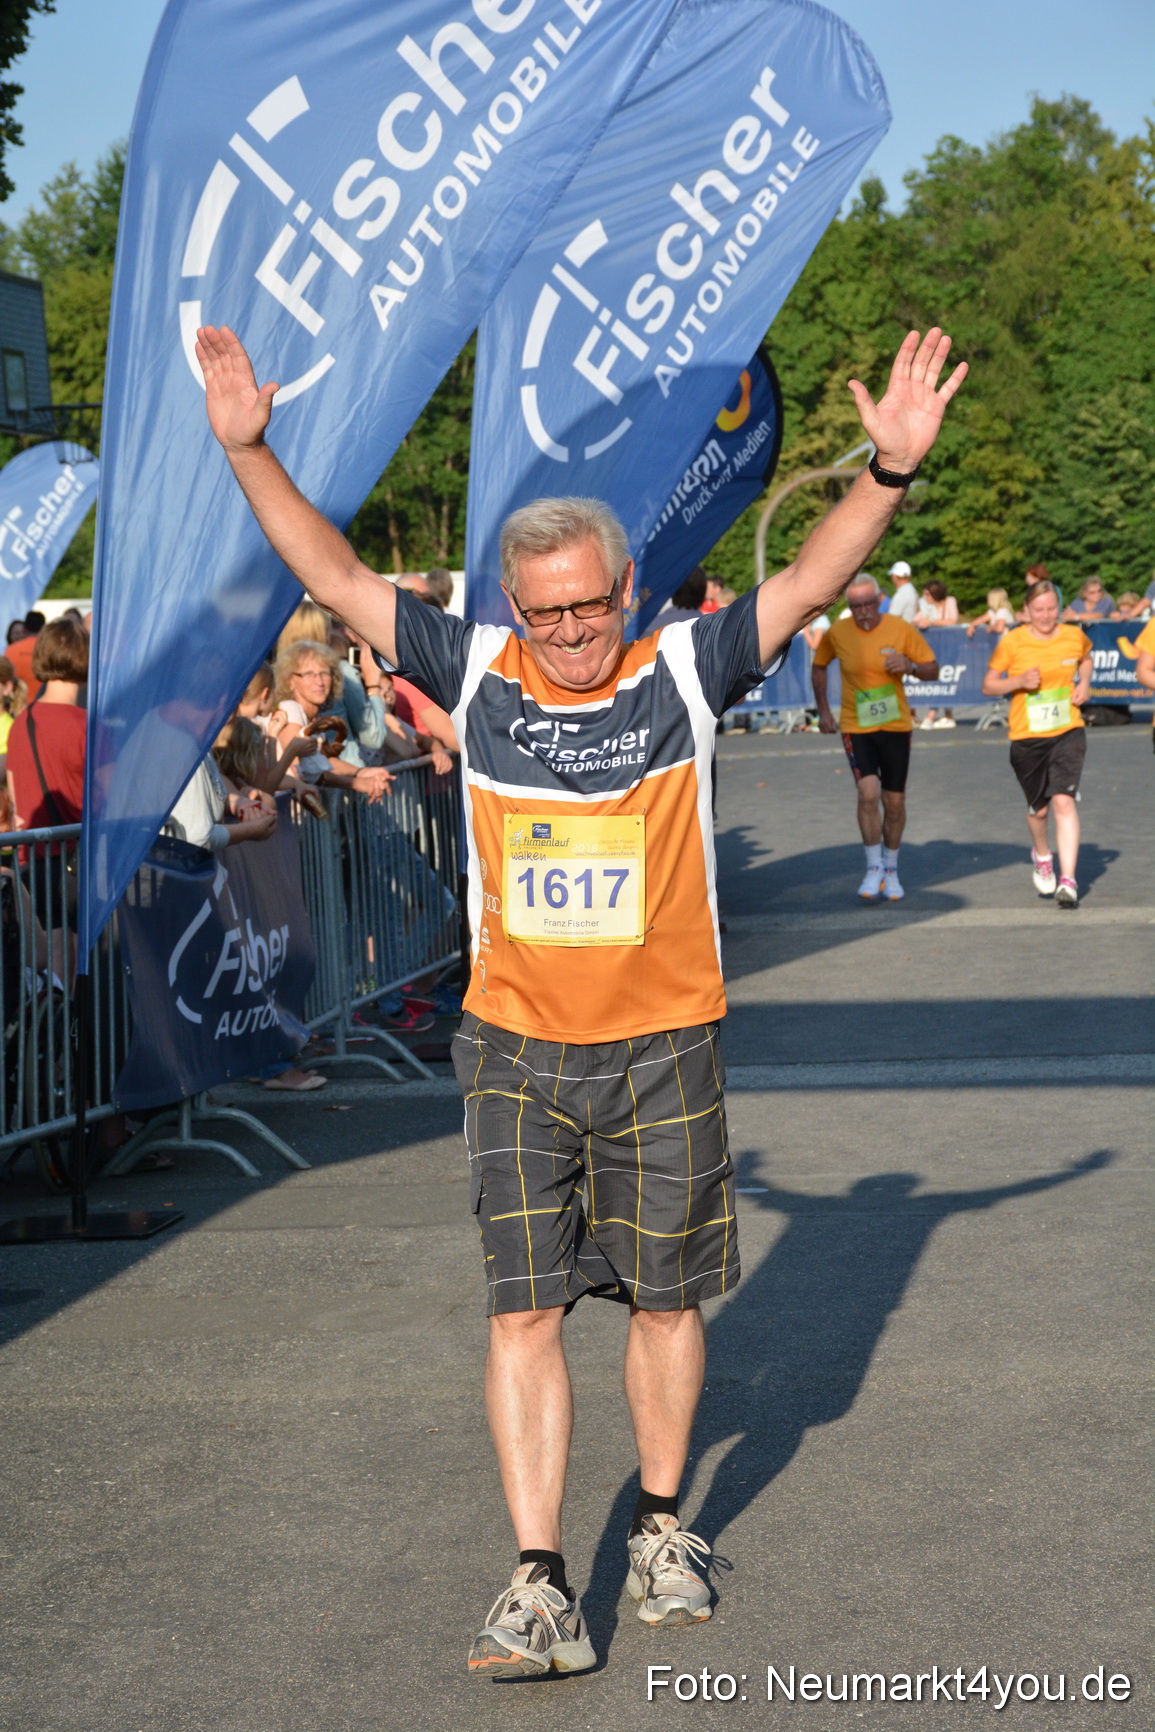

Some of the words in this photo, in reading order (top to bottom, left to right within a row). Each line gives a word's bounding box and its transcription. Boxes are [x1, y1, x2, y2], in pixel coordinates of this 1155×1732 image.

[369, 0, 602, 331] AUTOMOBILE
[573, 67, 791, 406] Fischer
[653, 126, 820, 398] AUTOMOBILE
[681, 484, 714, 526] Druck
[733, 420, 772, 473] Medien
[11, 464, 77, 562] Fischer
[905, 684, 958, 697] OMOBILE
[870, 702, 887, 717] 53
[1041, 705, 1060, 720] 74
[545, 752, 646, 773] UTOMOBILE
[511, 850, 547, 861] walken
[524, 836, 570, 847] firmenlauf
[517, 867, 630, 909] 1617
[543, 918, 566, 928] Franz
[567, 919, 600, 928] Fischer
[203, 918, 290, 998] Fisher
